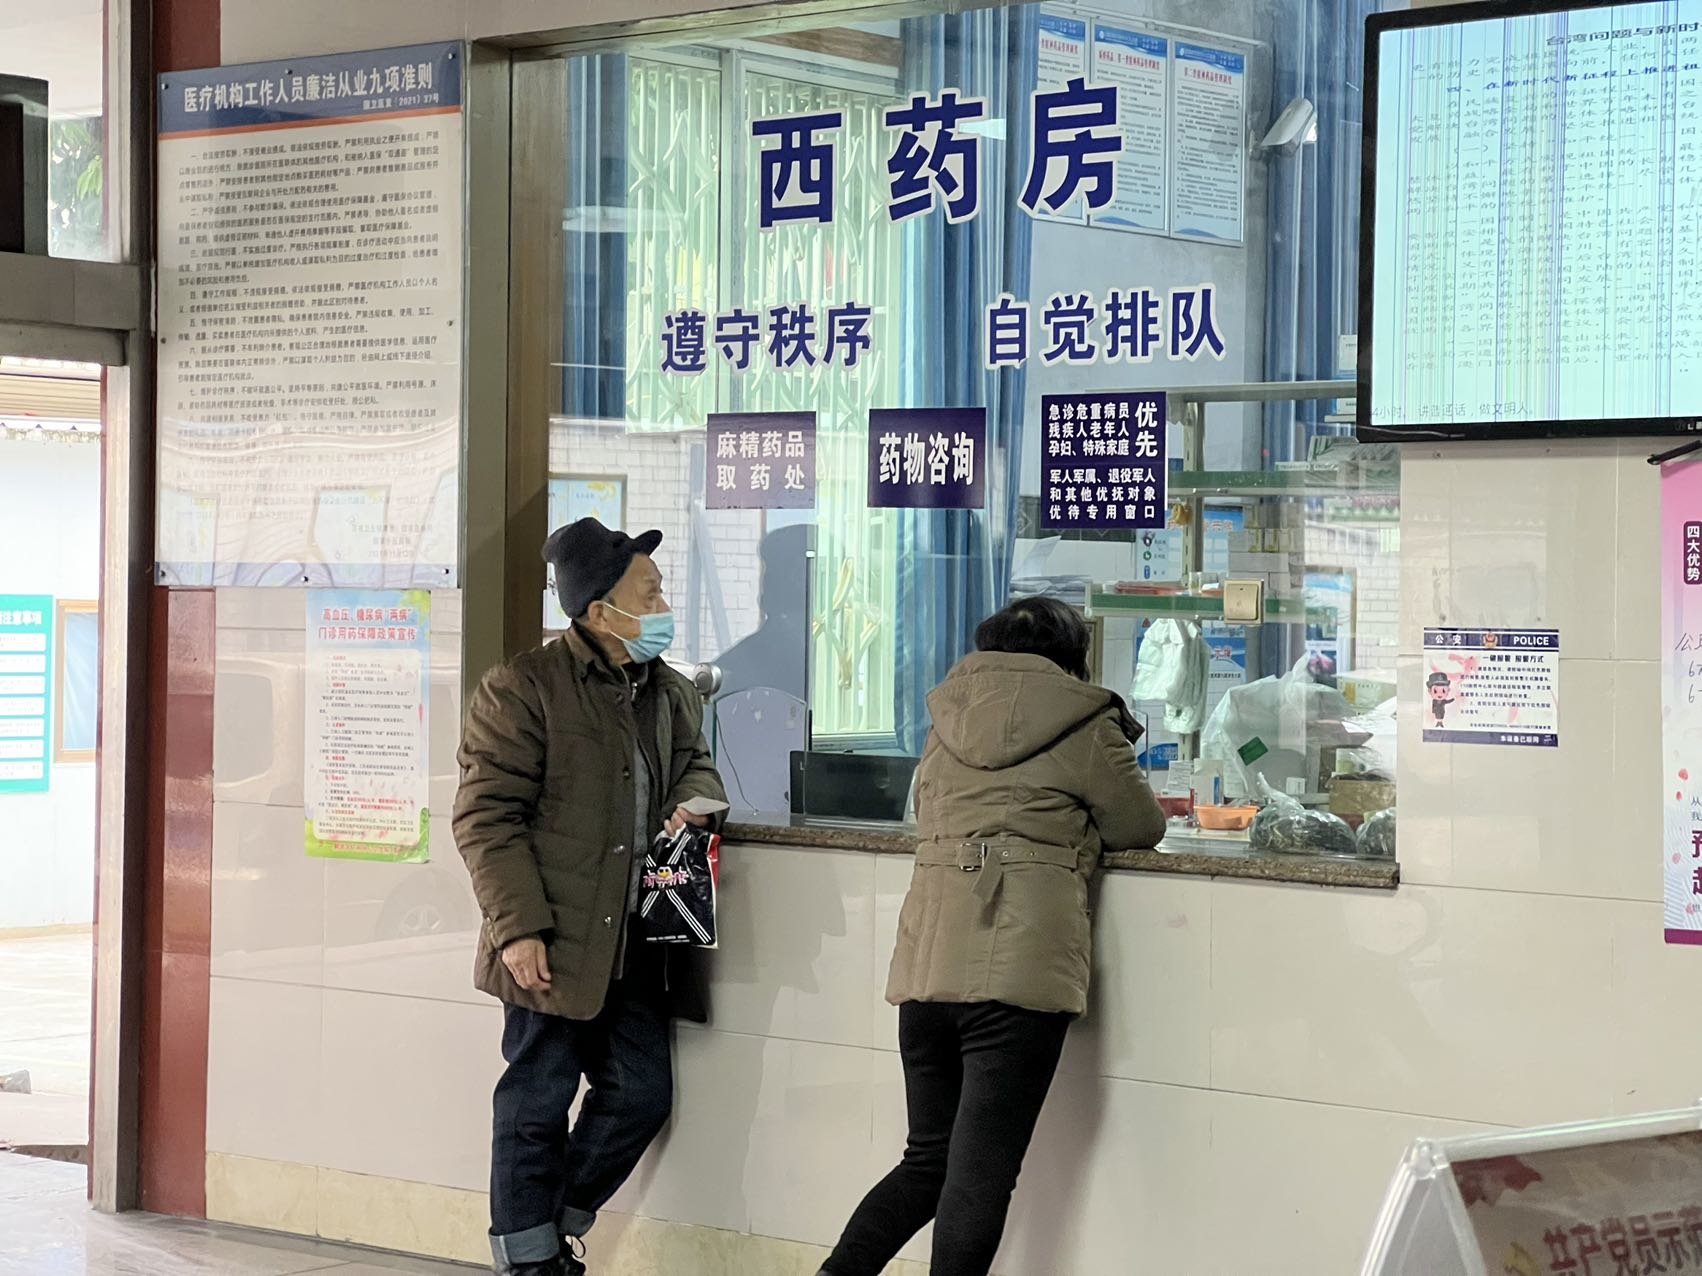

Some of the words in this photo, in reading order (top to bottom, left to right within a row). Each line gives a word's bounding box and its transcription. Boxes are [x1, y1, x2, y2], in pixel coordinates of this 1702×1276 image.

[1547, 21, 1702, 45] 台湾问题与新时
[184, 62, 433, 113] 医疗机构工作人员廉洁从业九项准则
[753, 77, 1123, 228] 西药房
[661, 302, 872, 374] 遵守秩序
[986, 287, 1224, 367] 自觉排队
[1049, 402, 1129, 420] 急诊危重病员
[1049, 421, 1129, 438] 残疾人老年人
[1135, 402, 1158, 457] 优先
[717, 431, 805, 458] 麻精药品
[1049, 439, 1129, 456] 孕妇、特殊家庭
[880, 432, 974, 485] 药物咨询
[717, 464, 805, 490] 取药处
[1050, 469, 1155, 484] 军人军属、退役军人
[1050, 487, 1156, 502] 和其他优抚对象
[1050, 505, 1155, 520] 优待专用窗口
[1687, 525, 1701, 581] 四大优势
[1435, 634, 1462, 645] 公安
[1513, 636, 1549, 646] POLICE
